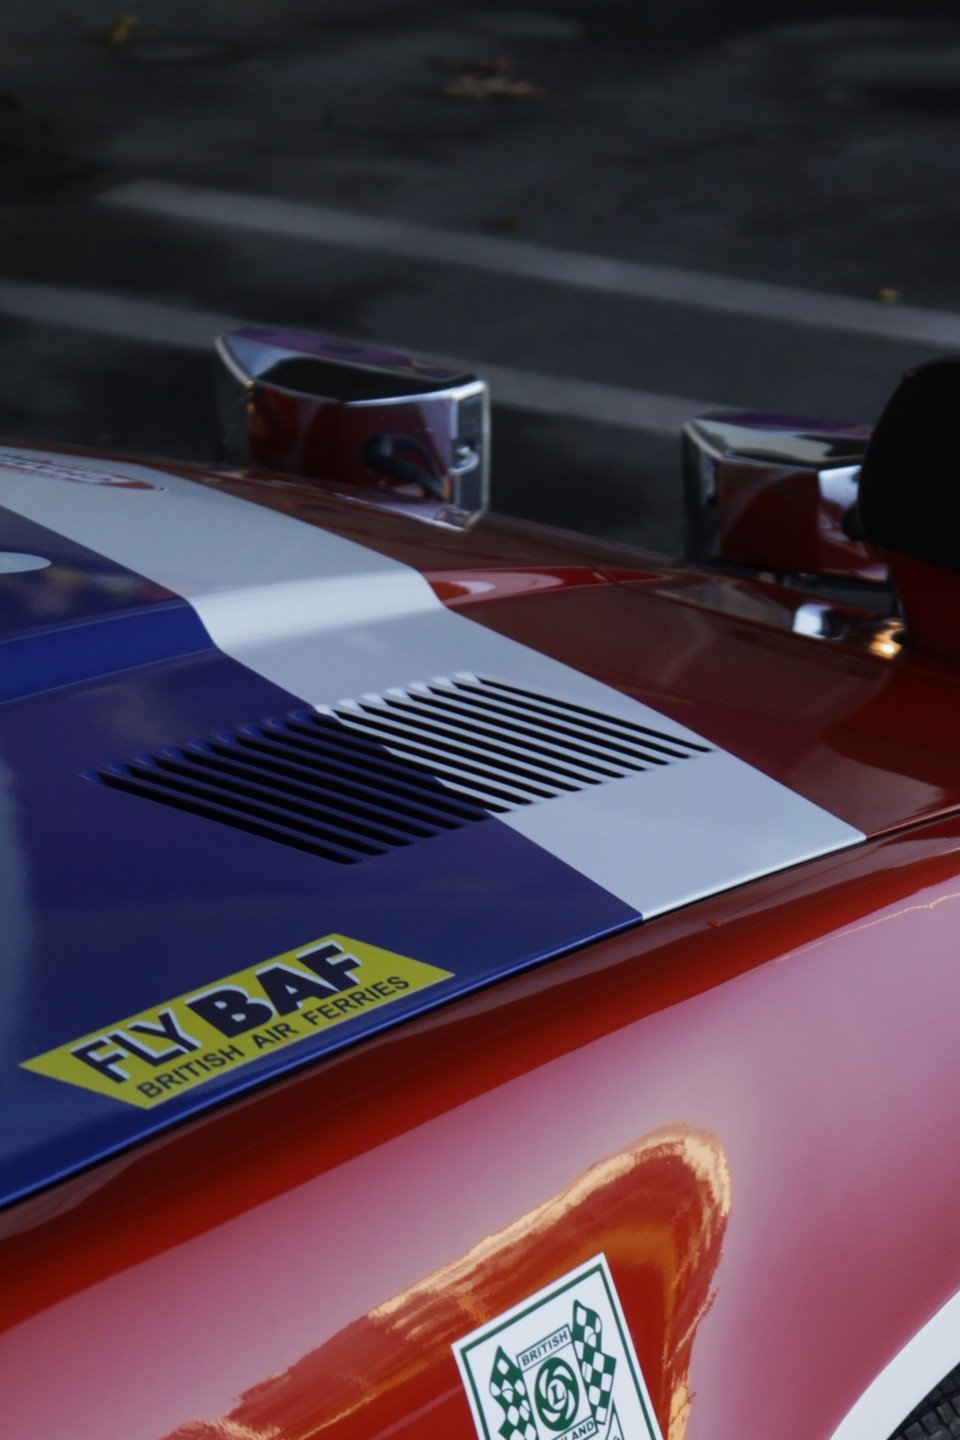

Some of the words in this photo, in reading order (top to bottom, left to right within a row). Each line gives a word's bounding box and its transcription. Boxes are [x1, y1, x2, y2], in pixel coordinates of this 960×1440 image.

[70, 1008, 201, 1083] FLY
[187, 940, 362, 1039] BAF
[136, 1045, 246, 1099] BRITISH
[252, 1022, 299, 1050] AIR
[302, 975, 410, 1026] FERRIES
[521, 1330, 569, 1366] BRITISH
